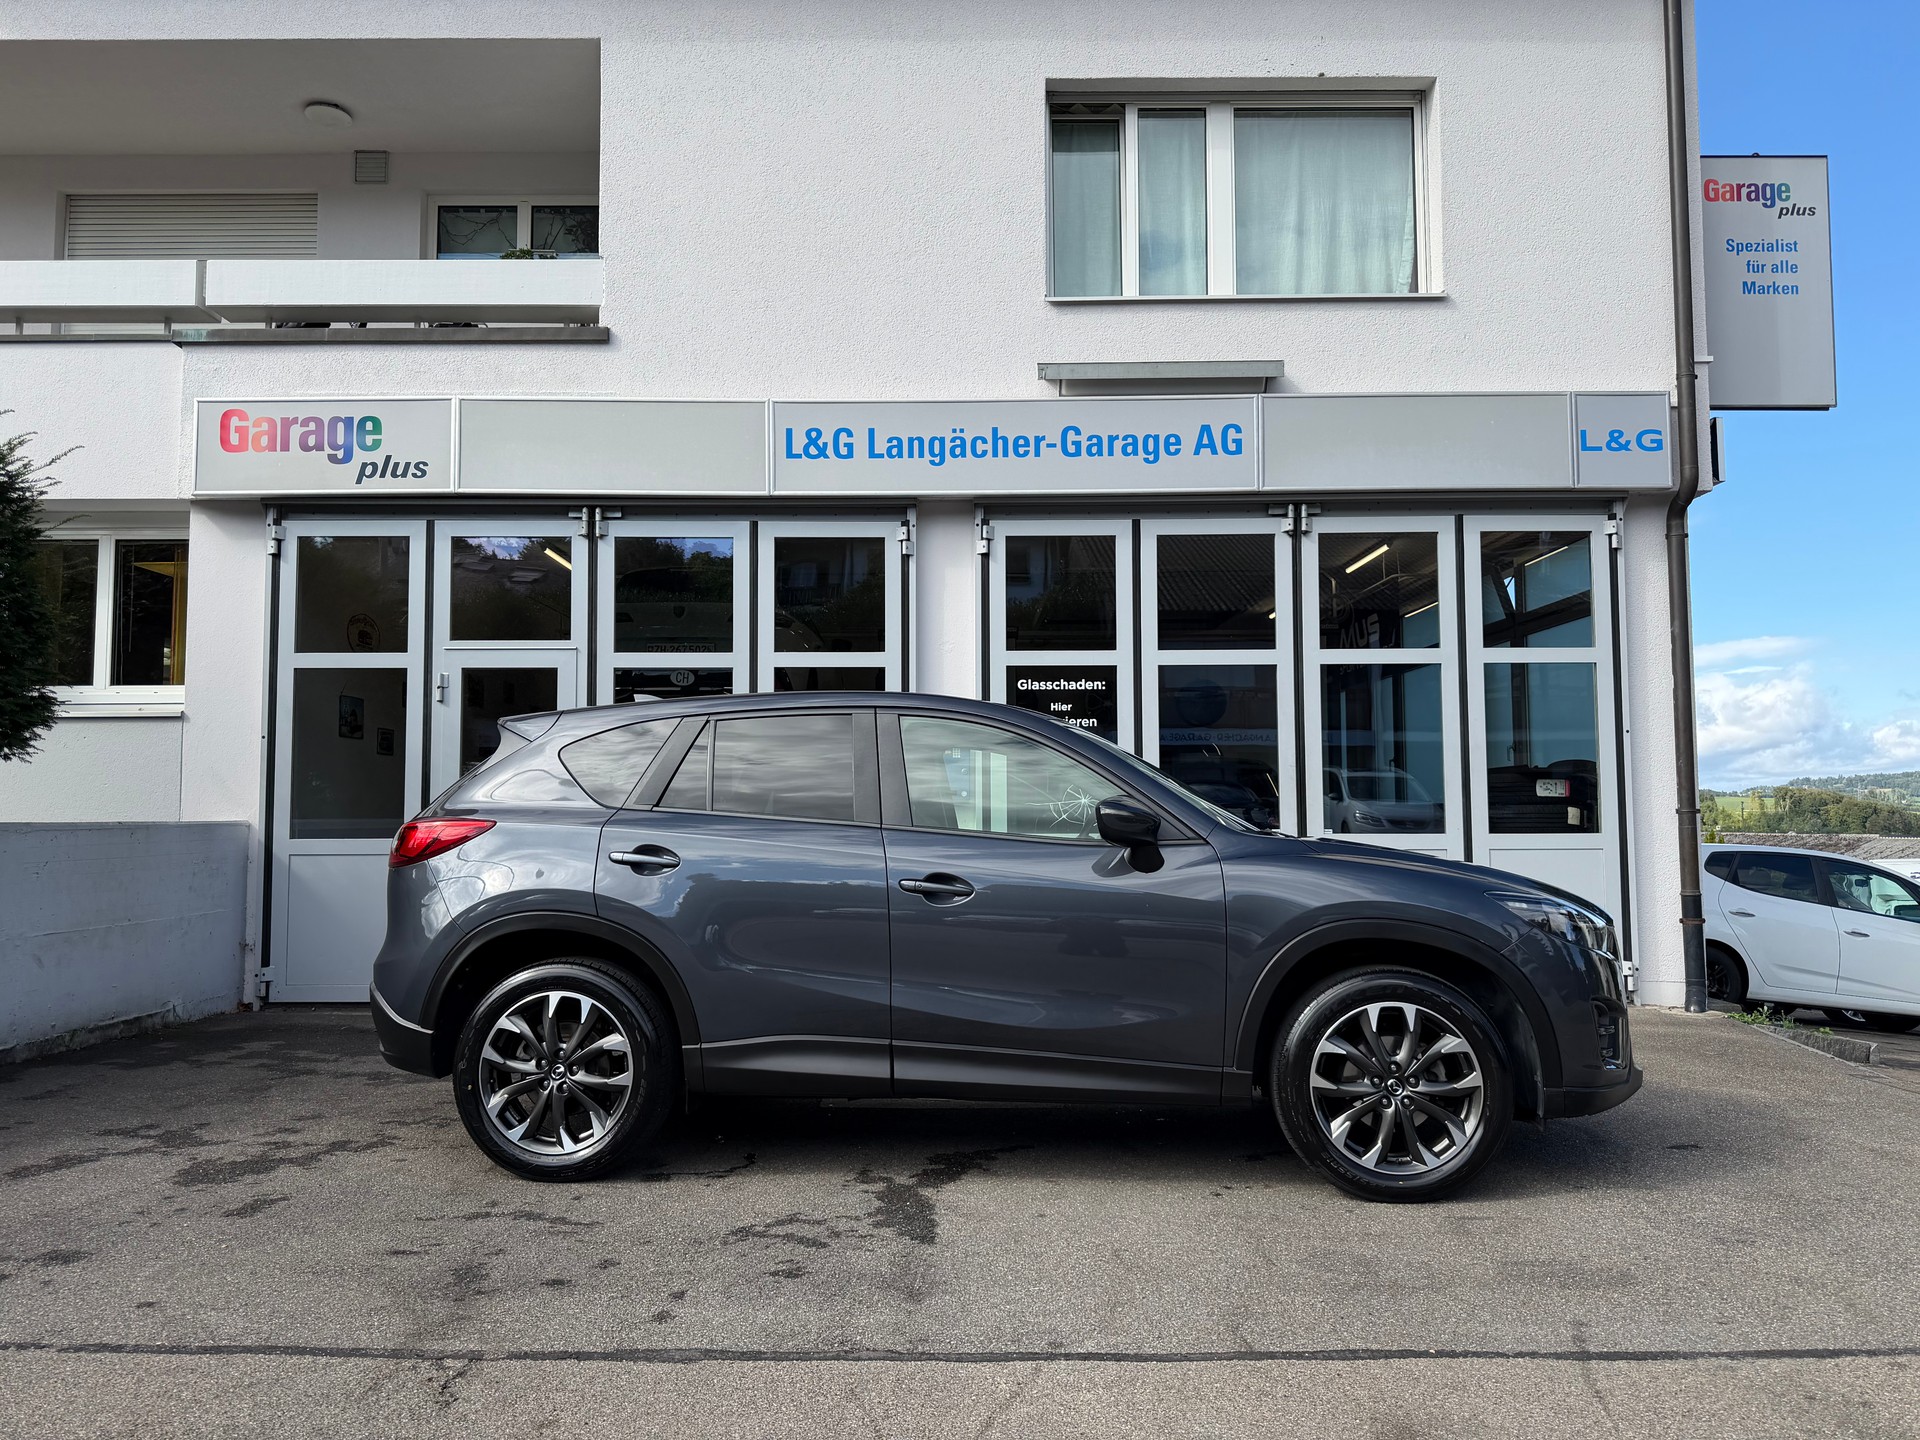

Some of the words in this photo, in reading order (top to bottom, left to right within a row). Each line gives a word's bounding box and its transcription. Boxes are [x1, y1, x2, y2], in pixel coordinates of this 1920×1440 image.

[1703, 178, 1791, 209] Garage
[1777, 203, 1816, 219] plus
[1725, 238, 1799, 256] Spezialist
[1746, 260, 1767, 274] für
[1771, 260, 1799, 274] alle
[1742, 281, 1799, 295] Marken
[219, 408, 383, 465] Garage
[1580, 428, 1664, 452] L&G
[785, 427, 855, 460] L&G
[867, 425, 1183, 467] Langächer-Garage
[1193, 423, 1243, 456] AG
[355, 454, 429, 485] plus
[675, 671, 690, 684] CH
[1017, 679, 1106, 690] Glasschaden:
[1050, 702, 1073, 711] Hier
[1062, 716, 1098, 727] ieren
